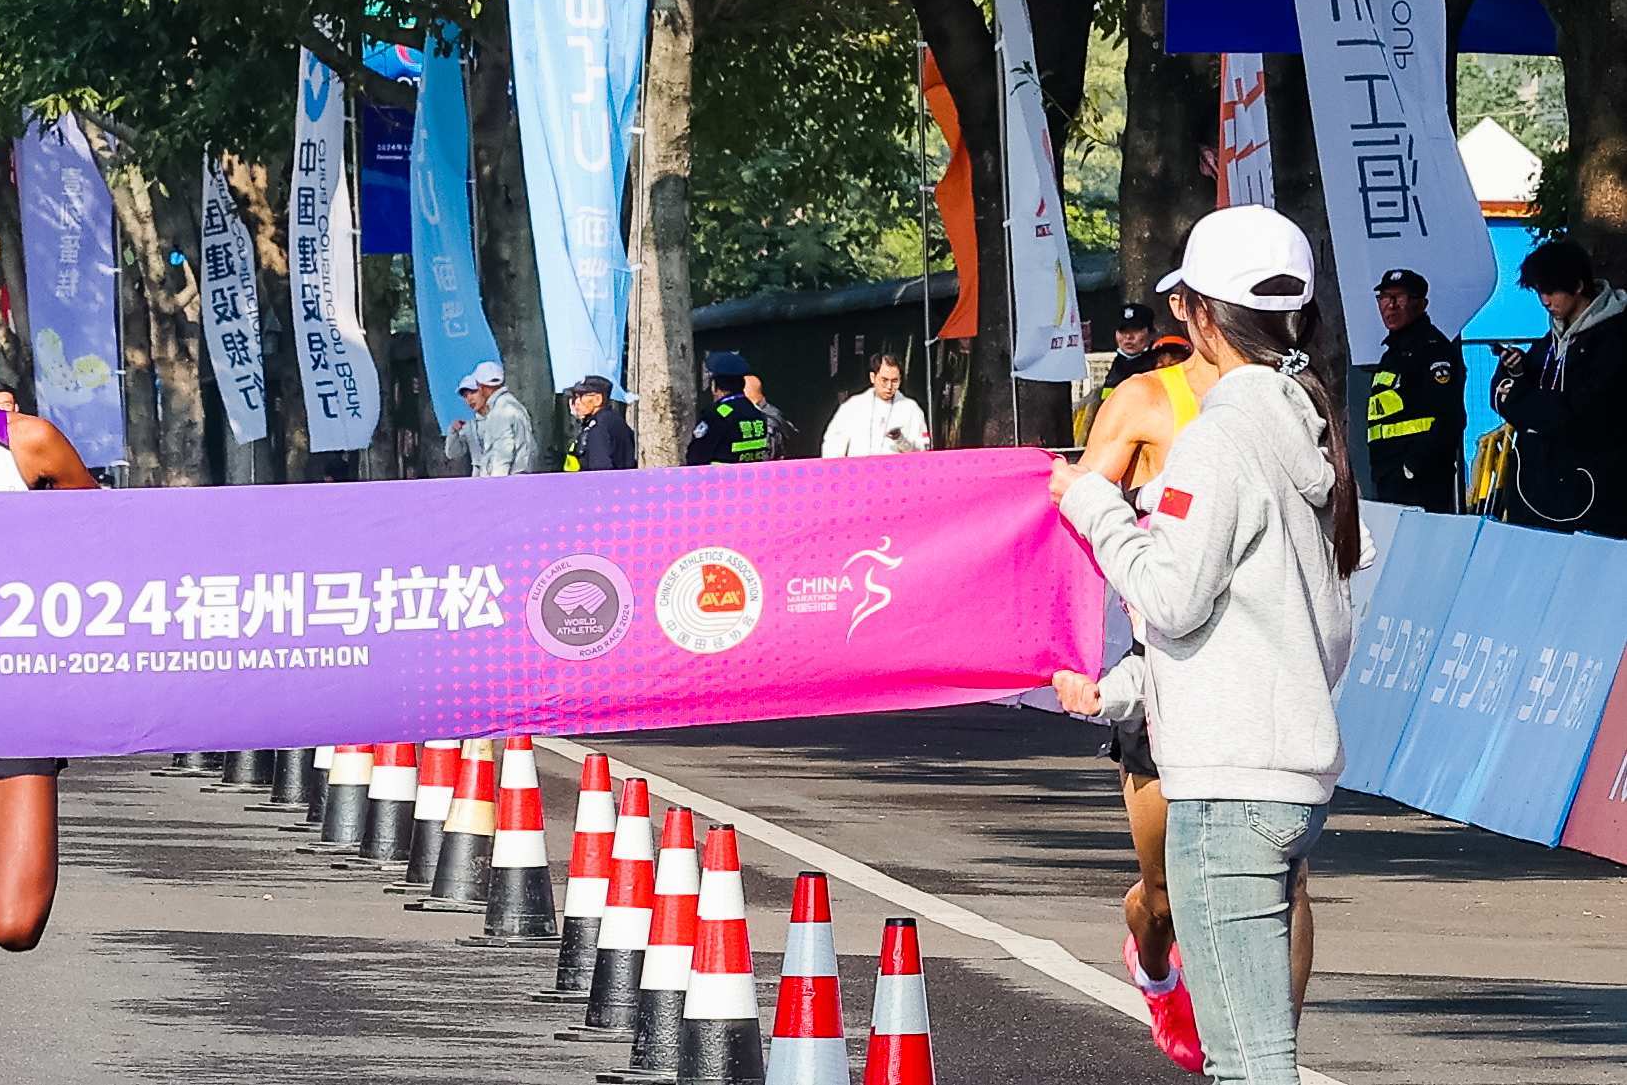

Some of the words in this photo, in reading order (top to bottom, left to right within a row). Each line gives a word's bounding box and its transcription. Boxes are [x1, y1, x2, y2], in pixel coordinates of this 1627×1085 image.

[786, 575, 854, 595] CHINA
[563, 617, 597, 627] WORLD
[556, 625, 605, 636] ATHLETICS
[135, 649, 233, 672] FUZHOU
[238, 645, 370, 670] MATATHON
